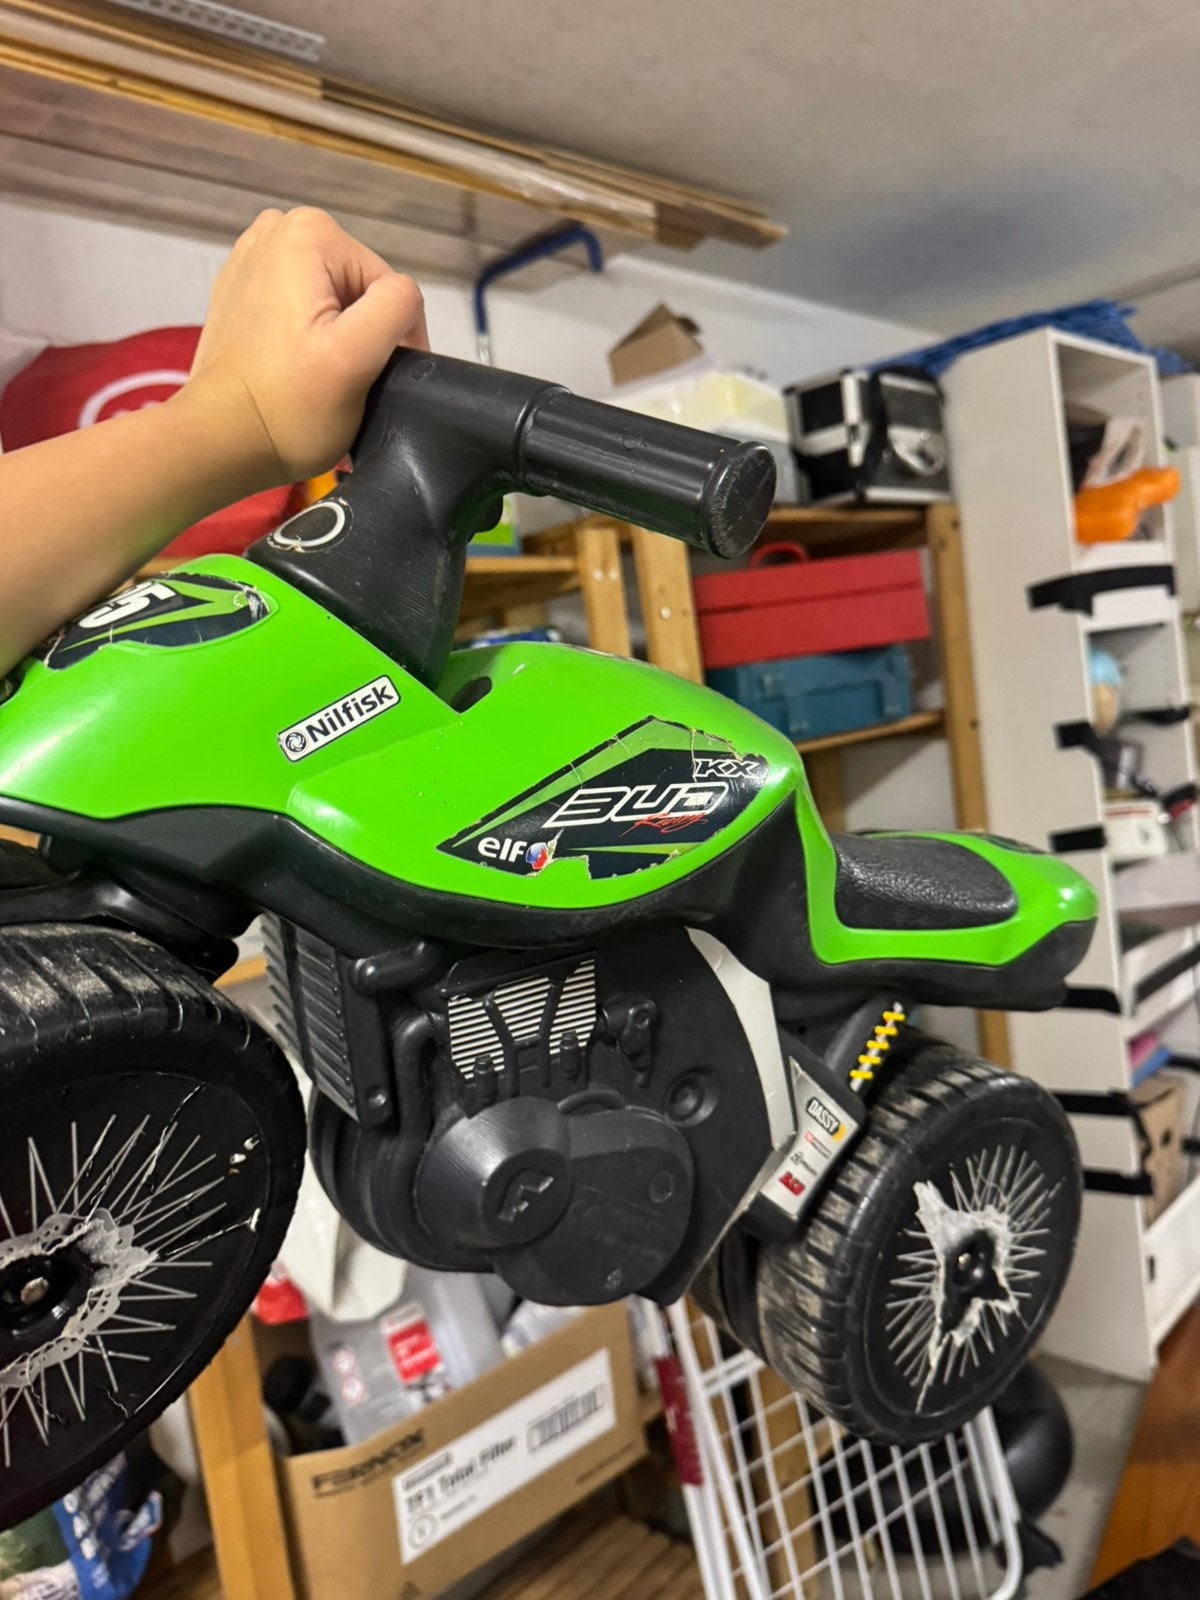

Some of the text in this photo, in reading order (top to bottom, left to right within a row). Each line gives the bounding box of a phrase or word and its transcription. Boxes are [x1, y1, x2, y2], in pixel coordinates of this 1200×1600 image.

[305, 685, 394, 743] Nilfisk
[693, 758, 766, 779] KX
[541, 781, 729, 829] BUD
[477, 836, 528, 863] elf
[807, 1099, 839, 1133] DASSY
